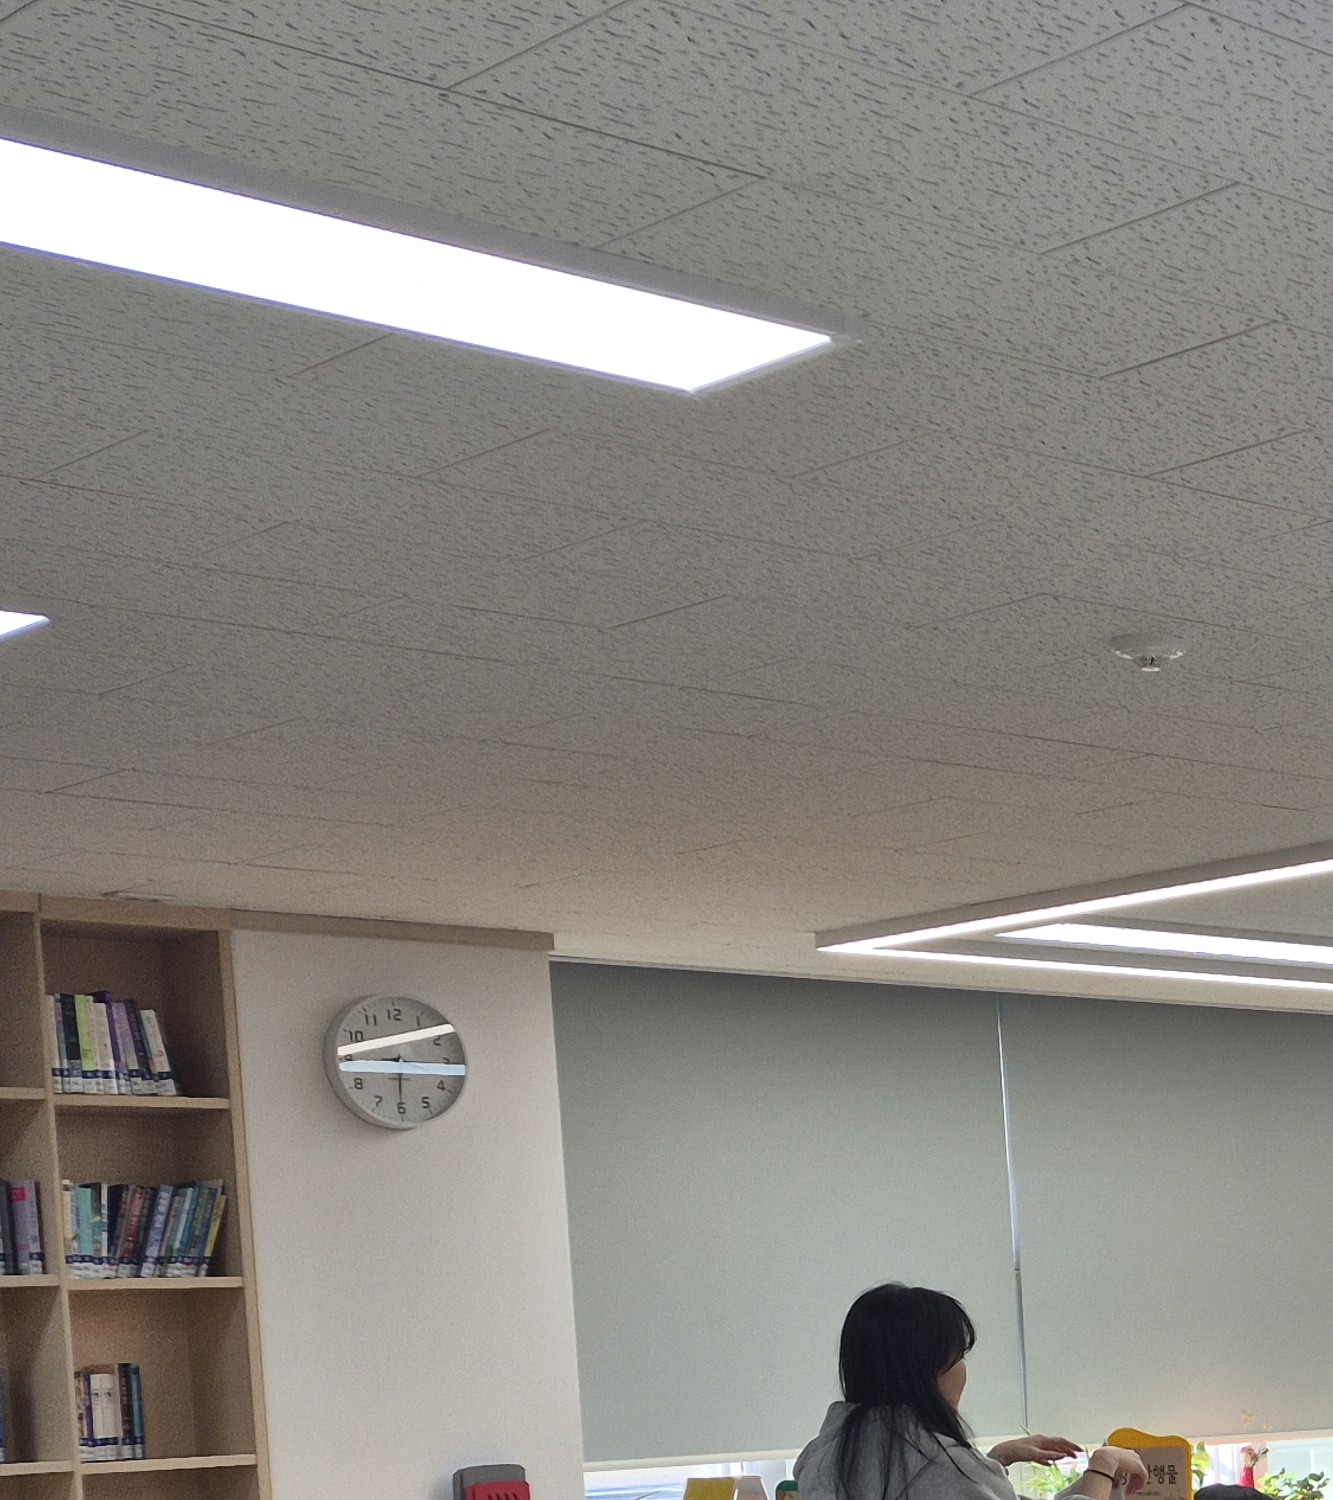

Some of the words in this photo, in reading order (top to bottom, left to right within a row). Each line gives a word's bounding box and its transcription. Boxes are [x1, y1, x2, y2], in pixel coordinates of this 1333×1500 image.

[365, 1014, 377, 1026] 11
[387, 1008, 402, 1022] 12
[416, 1015, 421, 1027] 1
[349, 1030, 364, 1042] 10
[353, 1077, 364, 1090] 8
[436, 1079, 446, 1091] 4
[373, 1095, 383, 1107] 7
[421, 1096, 430, 1109] 5
[396, 1101, 407, 1114] 6
